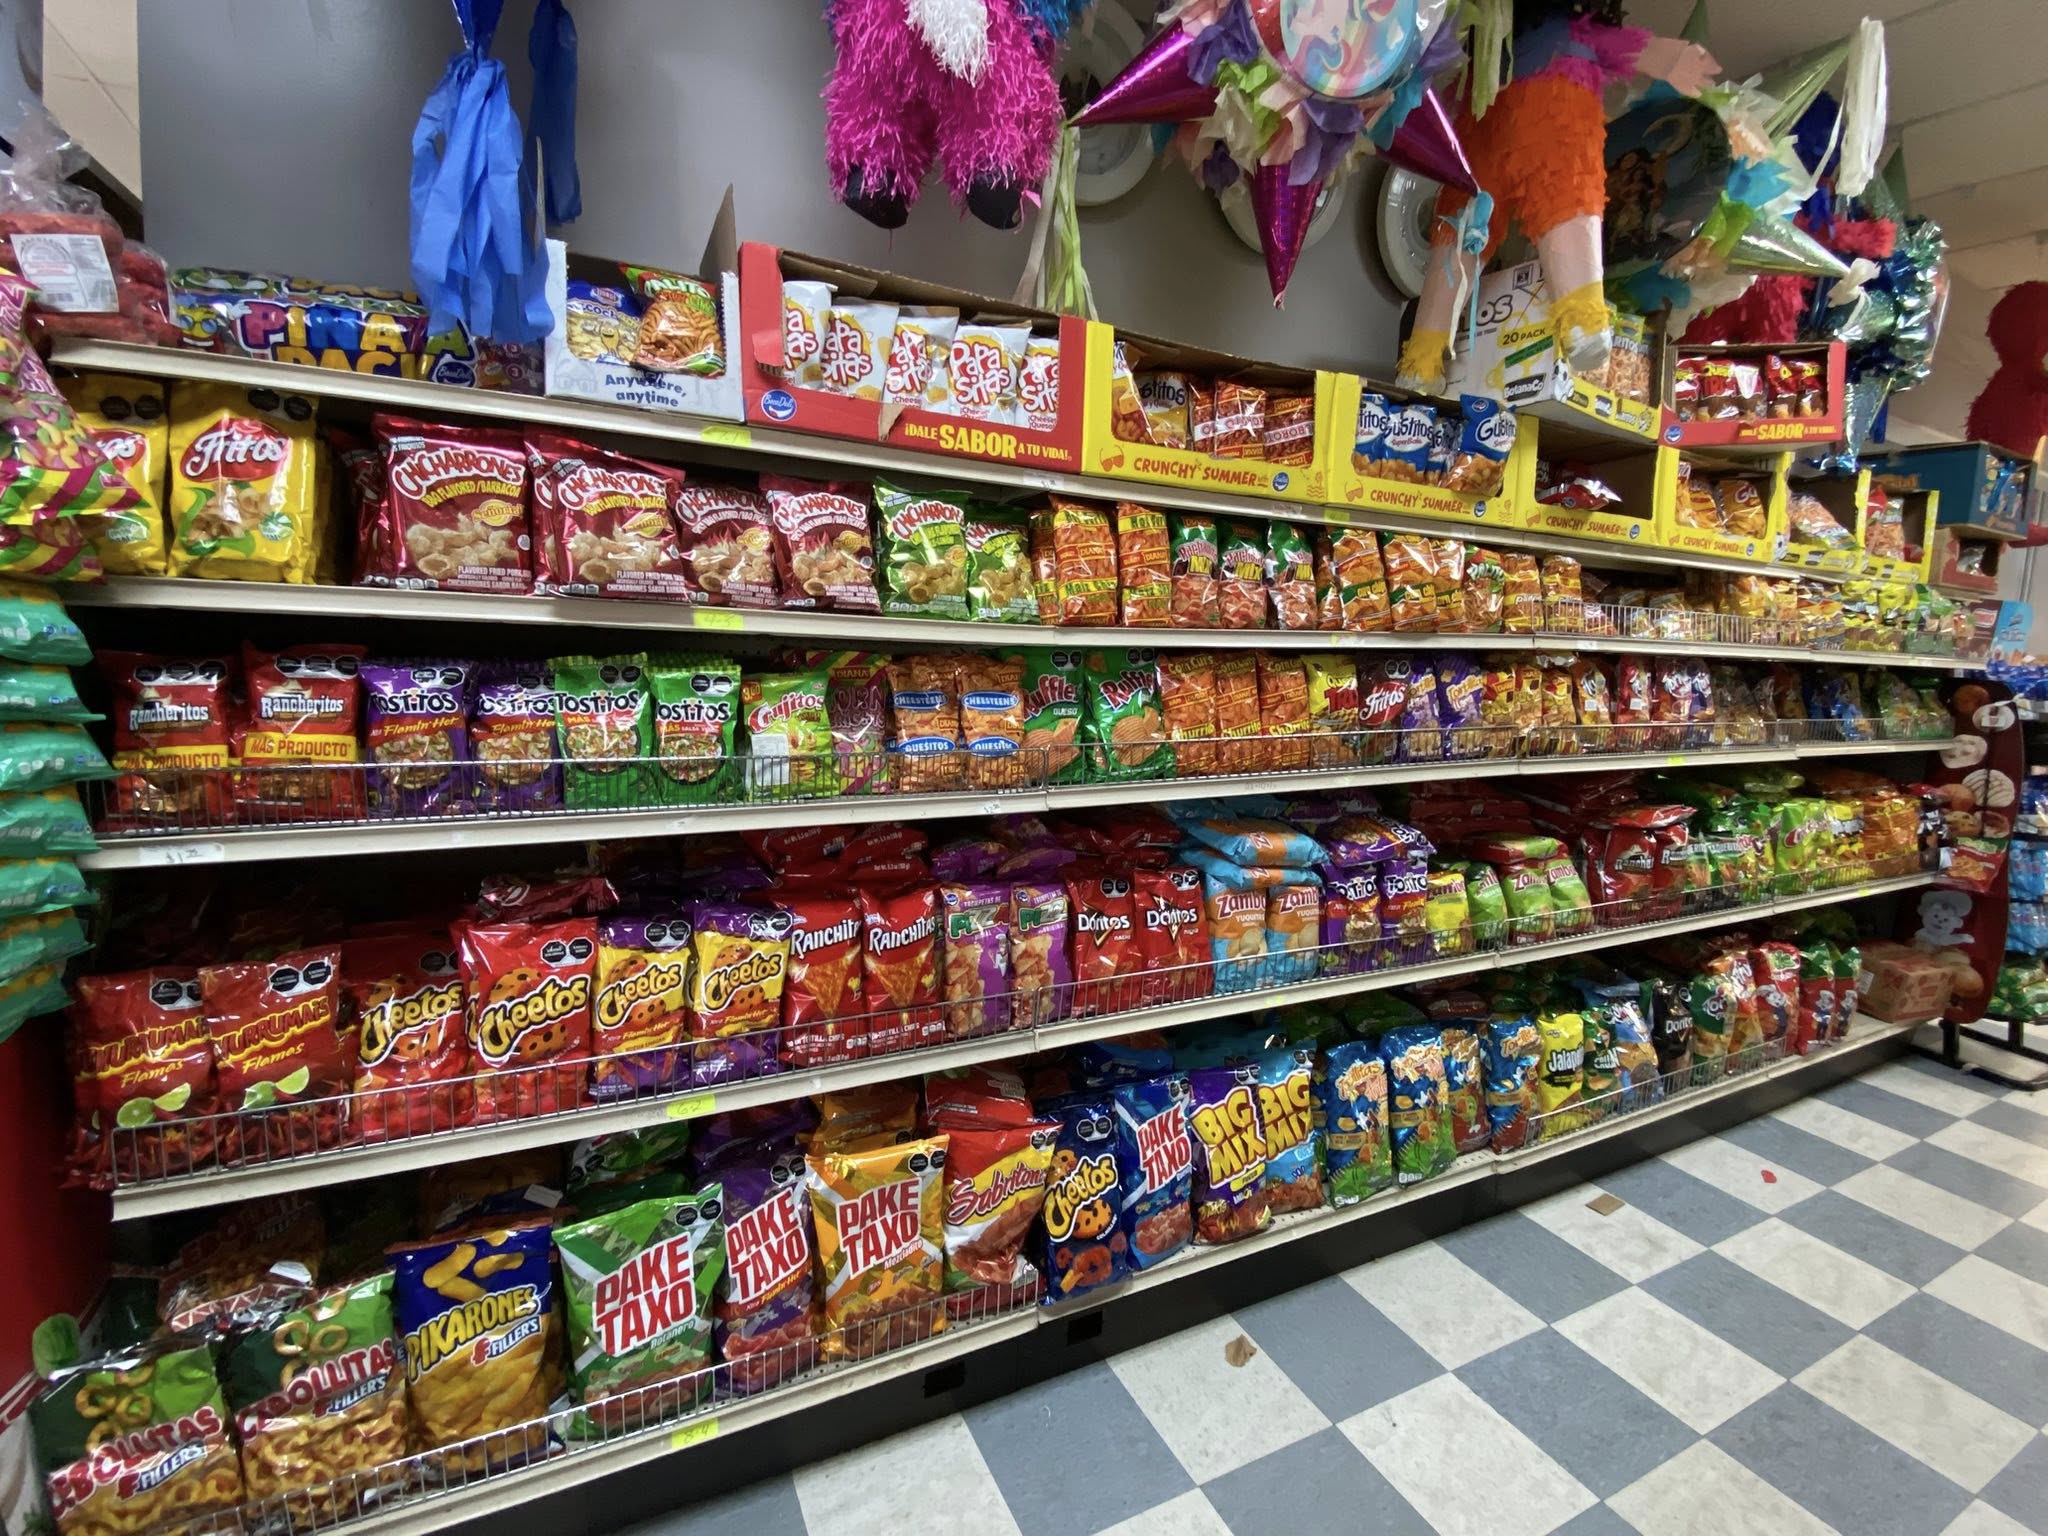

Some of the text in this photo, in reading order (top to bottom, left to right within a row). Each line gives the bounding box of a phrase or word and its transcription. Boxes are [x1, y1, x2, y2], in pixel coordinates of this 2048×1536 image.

[1503, 328, 1546, 346] 20 PACK
[616, 388, 679, 407] anytime
[1504, 378, 1545, 397] BotanaCo
[905, 423, 1068, 460] ¡DALE SABOR A TU VIDA!
[1758, 423, 1804, 440] SABOR
[187, 429, 285, 478] Fritos
[1133, 457, 1197, 479] CRUNCHY
[1202, 466, 1258, 486] SUMMER
[393, 448, 526, 499] CHICHARRONES
[1370, 489, 1463, 514] CRUNCHY SUMMER
[1546, 515, 1621, 536] CRUNCHY SUMMER
[1684, 535, 1712, 550] CRUNCHY
[129, 704, 210, 731] Rancheritos
[261, 694, 344, 718] Rancheritos
[658, 700, 730, 721] OSTITOS
[1053, 708, 1078, 716] QUESO
[1360, 685, 1405, 720] Fritos
[252, 736, 348, 757] MÁS PRODUCTO
[904, 740, 949, 752] QUESITOS
[1146, 908, 1197, 928] Doritos
[1278, 886, 1320, 914] Zamb
[1078, 913, 1130, 932] Doritos
[598, 963, 682, 1028] Cheetos
[703, 953, 782, 1010] Cheetos
[359, 982, 463, 1064] Cheetos
[479, 977, 590, 1060] Cheetos
[120, 1061, 184, 1088] Flamas
[242, 1043, 305, 1074] Flamas
[1194, 1091, 1252, 1145] BIG
[1259, 1073, 1311, 1126] BIG
[1138, 1105, 1185, 1158] PAKE
[1265, 1107, 1313, 1160] MIX
[1142, 1134, 1191, 1192] TAXO
[1209, 1122, 1267, 1185] MIX
[839, 1179, 920, 1237] PAKE
[1044, 1156, 1118, 1241] Cheetos
[727, 1192, 799, 1264] PAKE
[842, 1211, 920, 1278] TAXO
[596, 1235, 692, 1314] PAKE
[732, 1229, 807, 1302] TAXO
[406, 1284, 541, 1383] PIKARONES
[489, 1317, 541, 1356] FILLER'S
[596, 1281, 694, 1357] TAXO
[650, 1319, 695, 1349] Botanero
[333, 1374, 388, 1411] FILLER'S
[140, 1444, 203, 1489] FILLER'S
